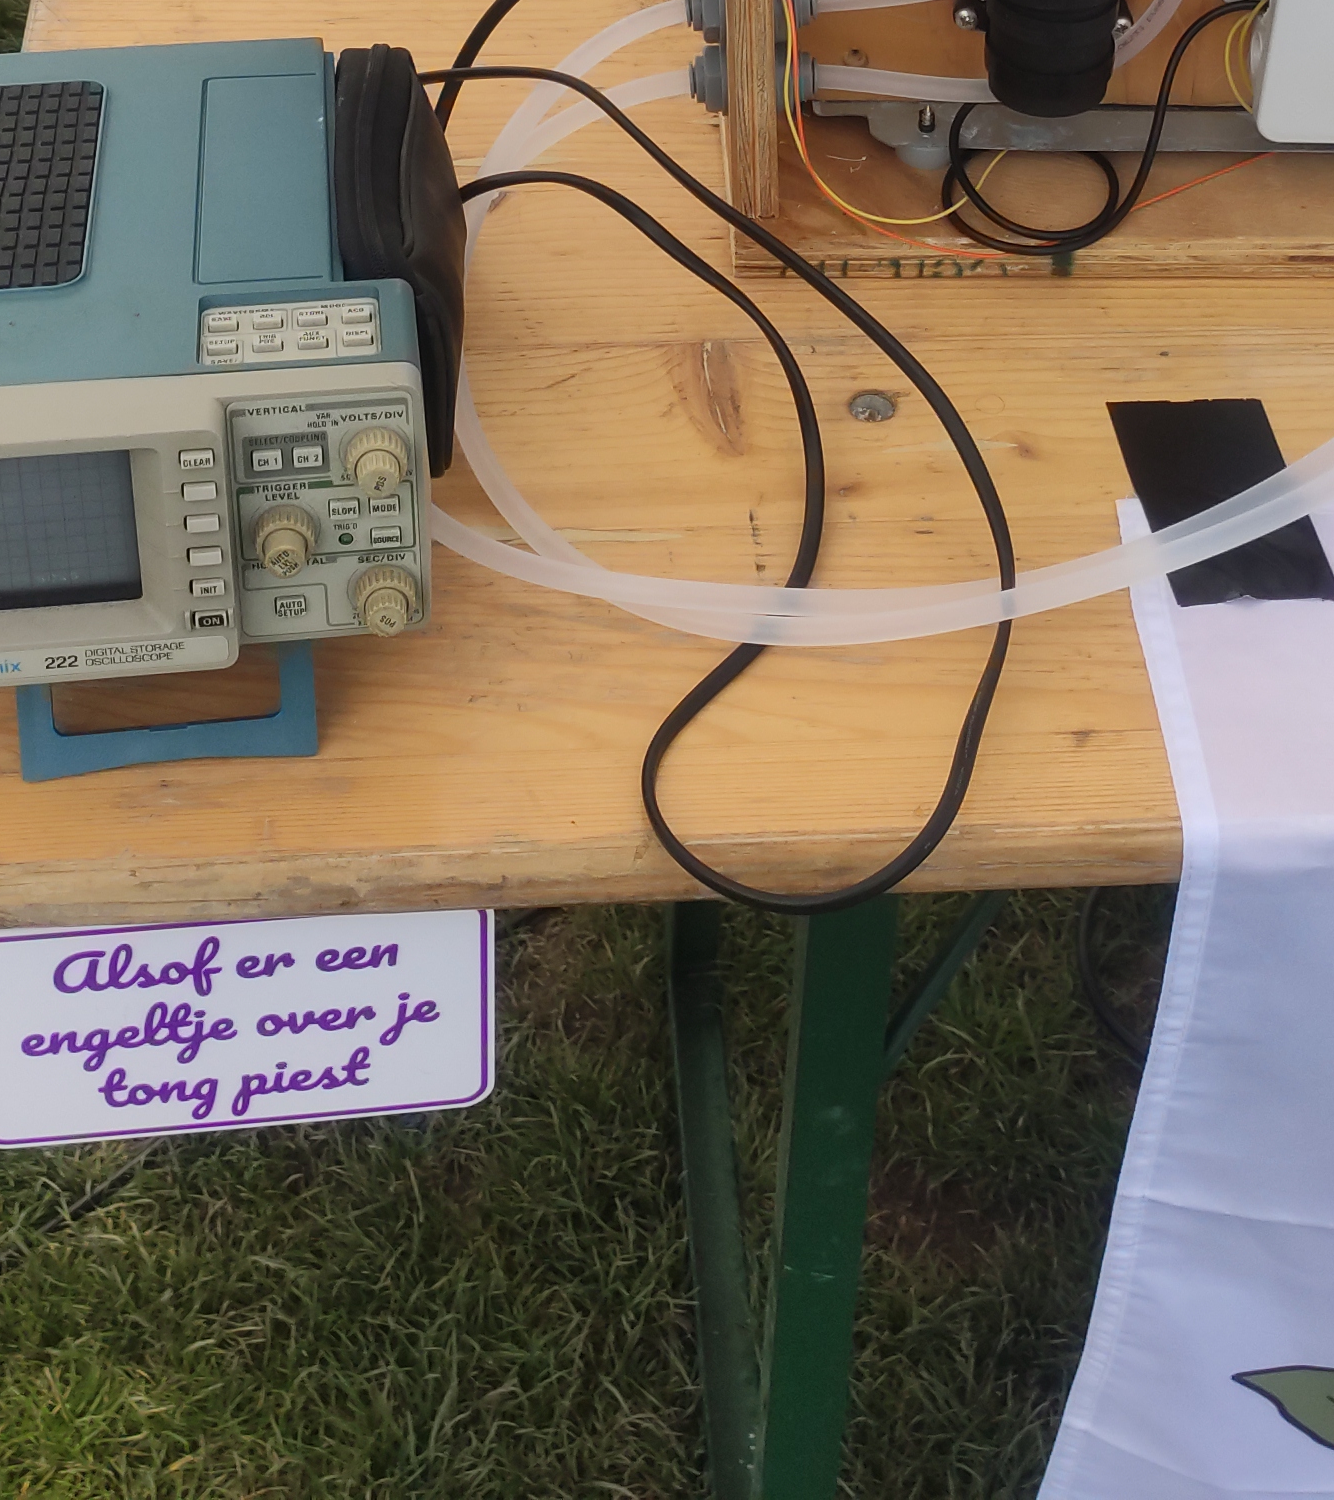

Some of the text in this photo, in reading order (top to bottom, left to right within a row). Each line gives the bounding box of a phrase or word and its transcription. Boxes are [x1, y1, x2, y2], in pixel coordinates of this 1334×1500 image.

[246, 404, 306, 417] VERTICAL
[339, 410, 405, 423] VOLTS/DIV
[248, 432, 327, 447] SELECT/COUPLING
[183, 457, 212, 468] CLEAR
[257, 457, 270, 467] CH
[297, 453, 320, 464] CH 2
[254, 481, 309, 494] TRIGGER
[265, 491, 301, 502] LEVEL
[331, 506, 358, 516] SLOPE
[372, 503, 398, 513] MODE
[372, 535, 400, 545] SOURCE
[270, 550, 291, 567] AUTO
[357, 552, 407, 565] SEC/DIV
[200, 584, 218, 596] INIT
[279, 600, 303, 609] AUTO
[277, 608, 306, 618] SETUP
[202, 615, 221, 626] ON
[84, 640, 187, 658] DIGITAL STORAGE
[44, 654, 80, 670] 222
[84, 651, 175, 667] OSCILLOSCOPE
[52, 935, 400, 997] Alsof er een
[20, 990, 442, 1072] engeltje over je
[96, 1045, 372, 1121] tong piest
